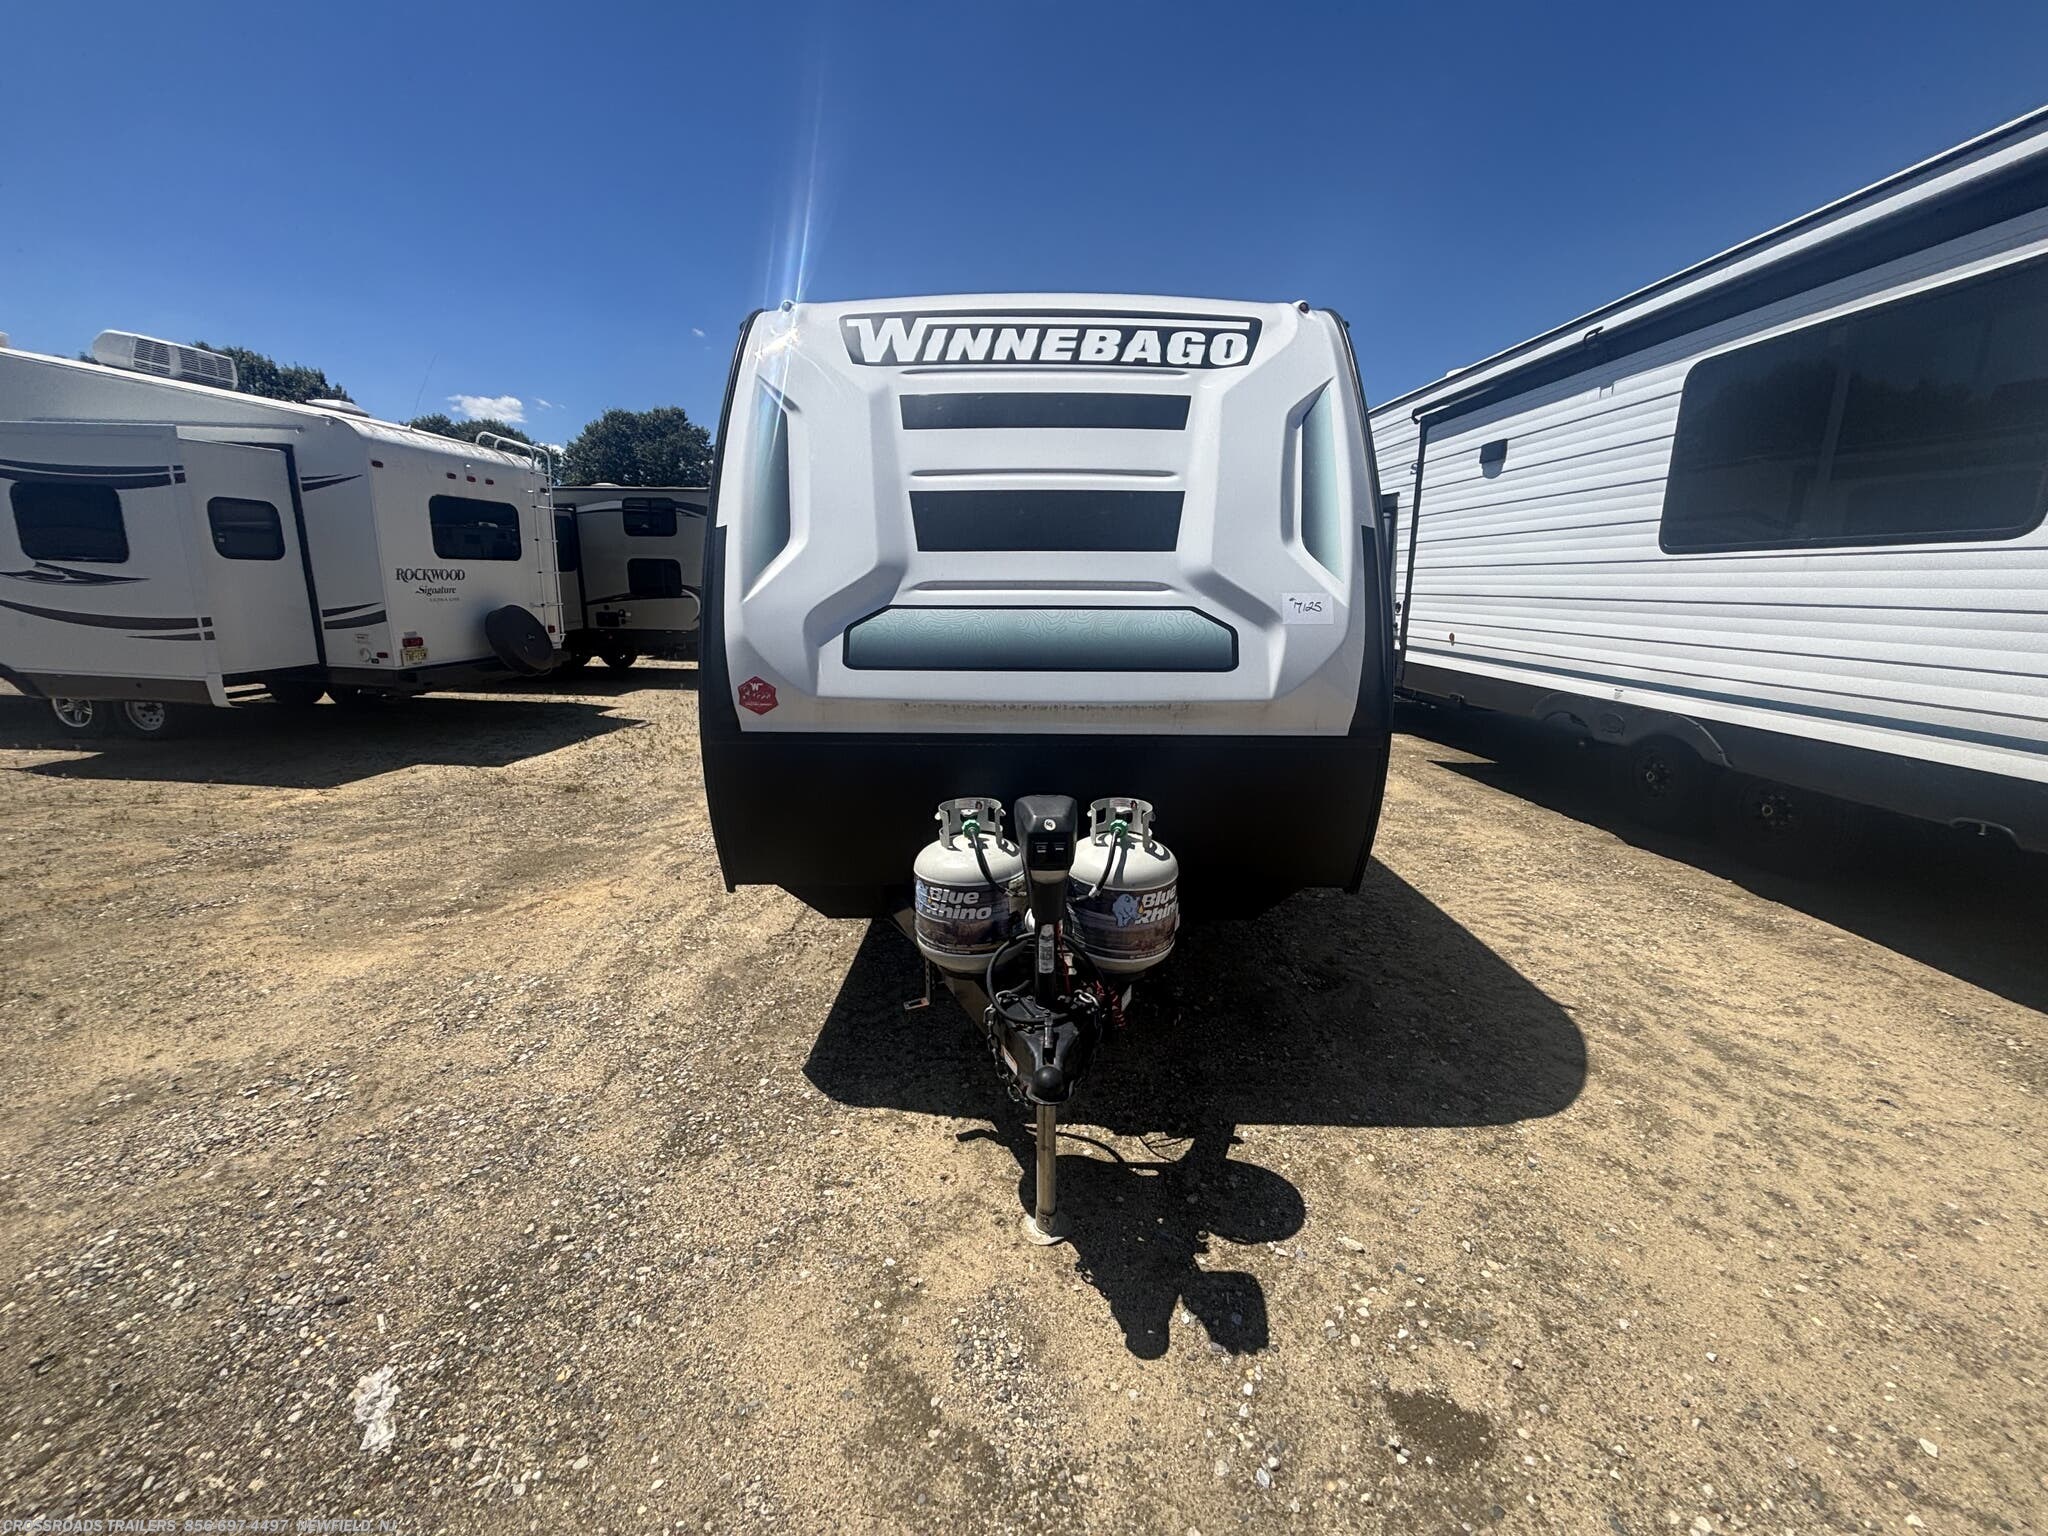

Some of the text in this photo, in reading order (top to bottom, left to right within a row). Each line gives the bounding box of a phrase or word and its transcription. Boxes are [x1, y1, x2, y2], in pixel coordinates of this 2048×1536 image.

[847, 317, 1249, 364] WINNEBAGO
[395, 567, 466, 583] ROCKWOOD
[416, 585, 457, 597] Signature
[929, 886, 979, 904] Blue
